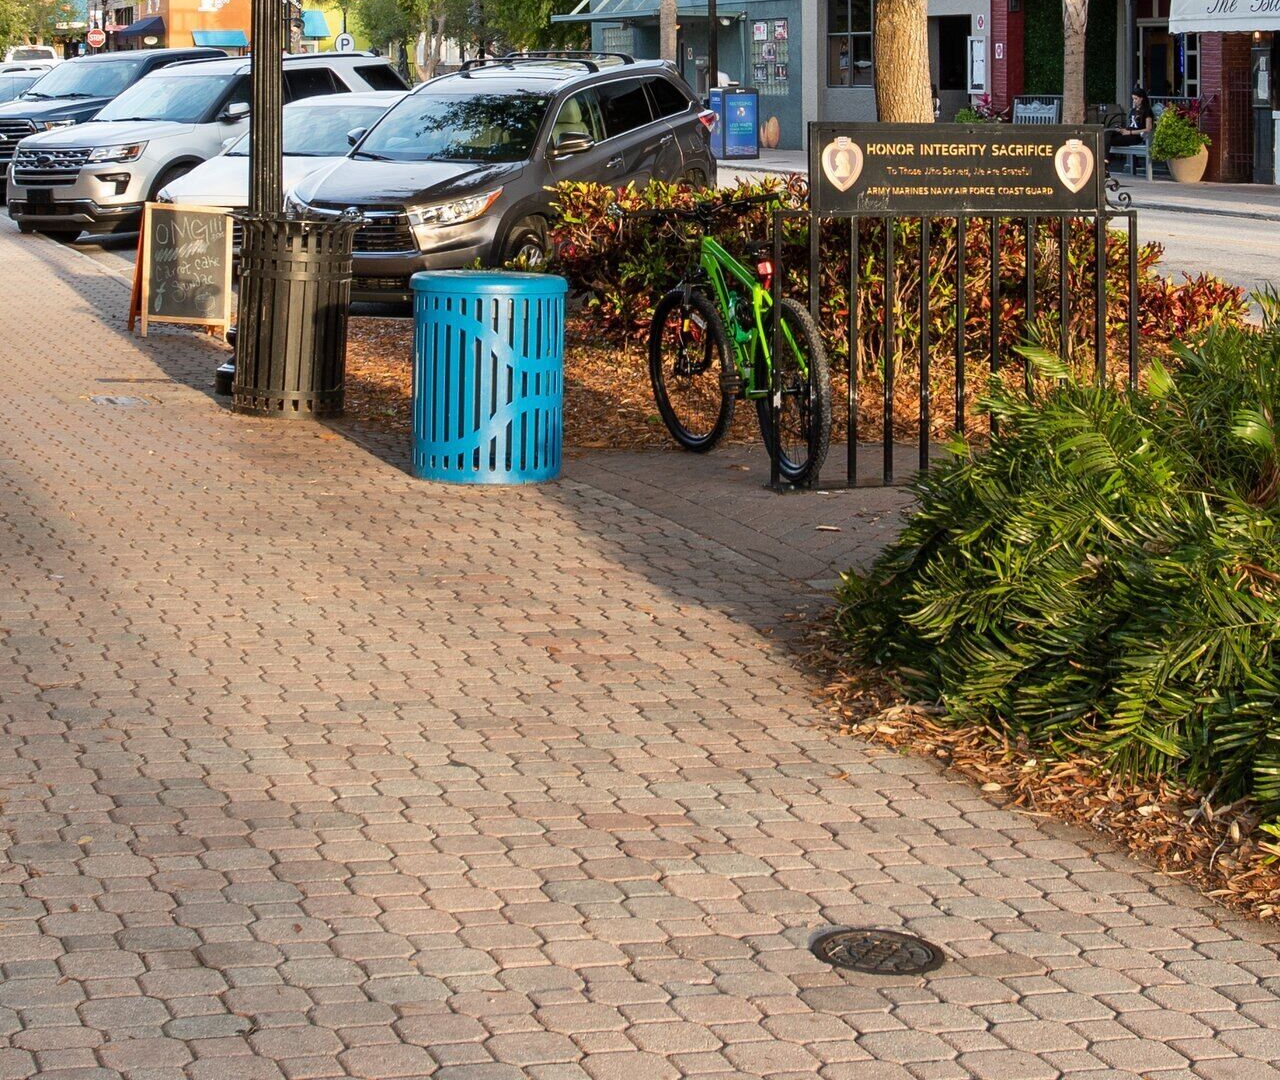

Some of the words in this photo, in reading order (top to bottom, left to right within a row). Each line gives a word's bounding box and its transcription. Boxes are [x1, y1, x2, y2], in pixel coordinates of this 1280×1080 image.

[341, 38, 350, 51] P
[866, 143, 915, 156] HONOR
[919, 143, 987, 156] INTEGRITY
[991, 144, 1054, 157] SACRIFICE
[886, 166, 898, 175] To
[898, 166, 922, 176] Those
[1001, 166, 1033, 176] Grateful
[867, 186, 891, 195] ARMY
[892, 186, 929, 195] MARINES
[930, 186, 954, 195] NAVY
[954, 186, 968, 195] AIR
[969, 187, 995, 195] FORCE
[997, 187, 1024, 195] COAST
[1025, 187, 1054, 195] GUARD
